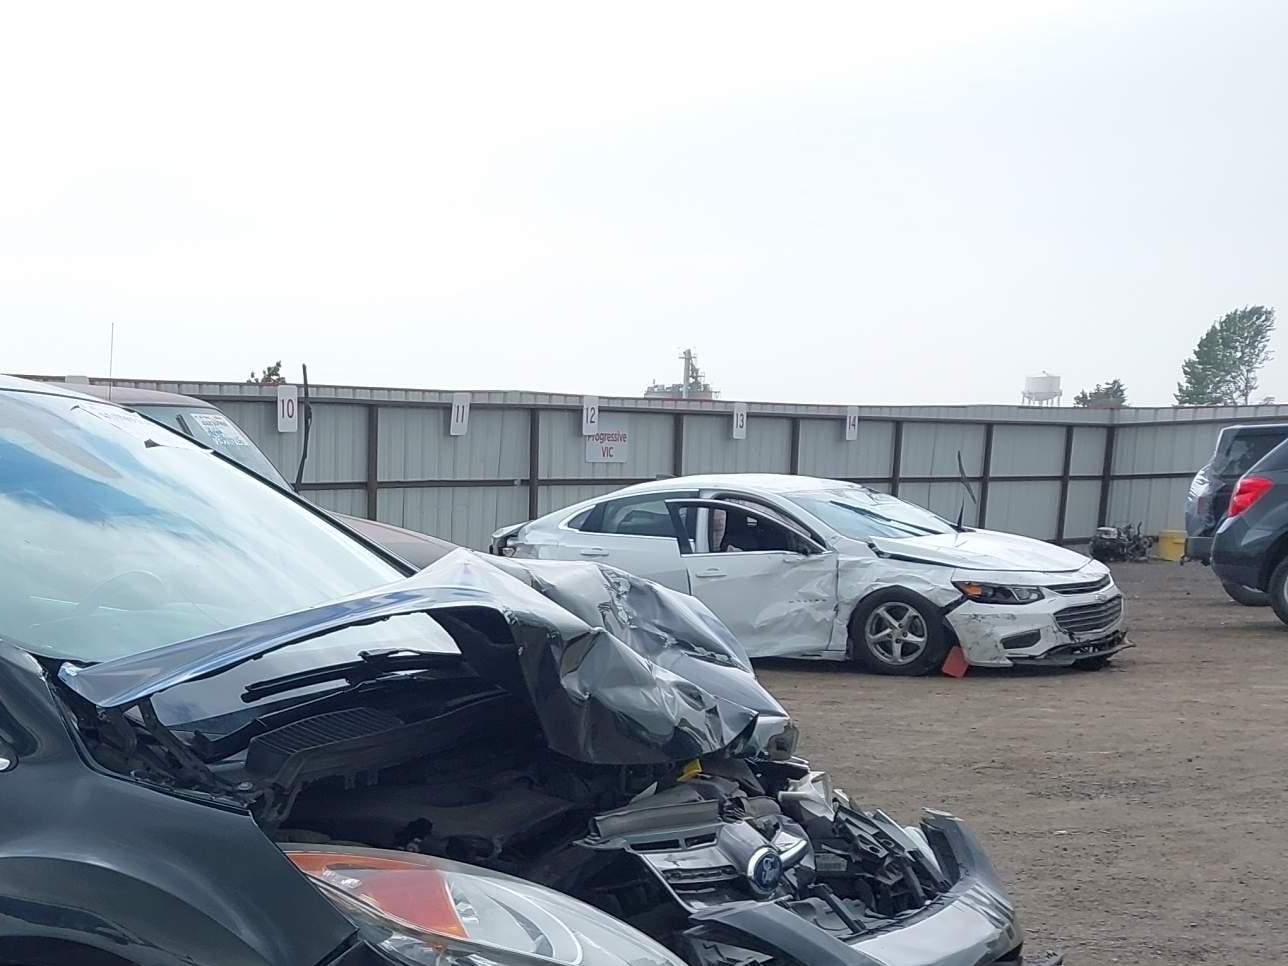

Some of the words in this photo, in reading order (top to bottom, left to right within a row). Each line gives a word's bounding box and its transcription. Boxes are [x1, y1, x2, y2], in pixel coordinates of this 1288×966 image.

[281, 399, 295, 419] 10
[455, 405, 465, 424] 11
[585, 407, 596, 425] 12
[735, 413, 745, 429] 13
[848, 416, 857, 431] 14
[601, 446, 615, 458] VIC
